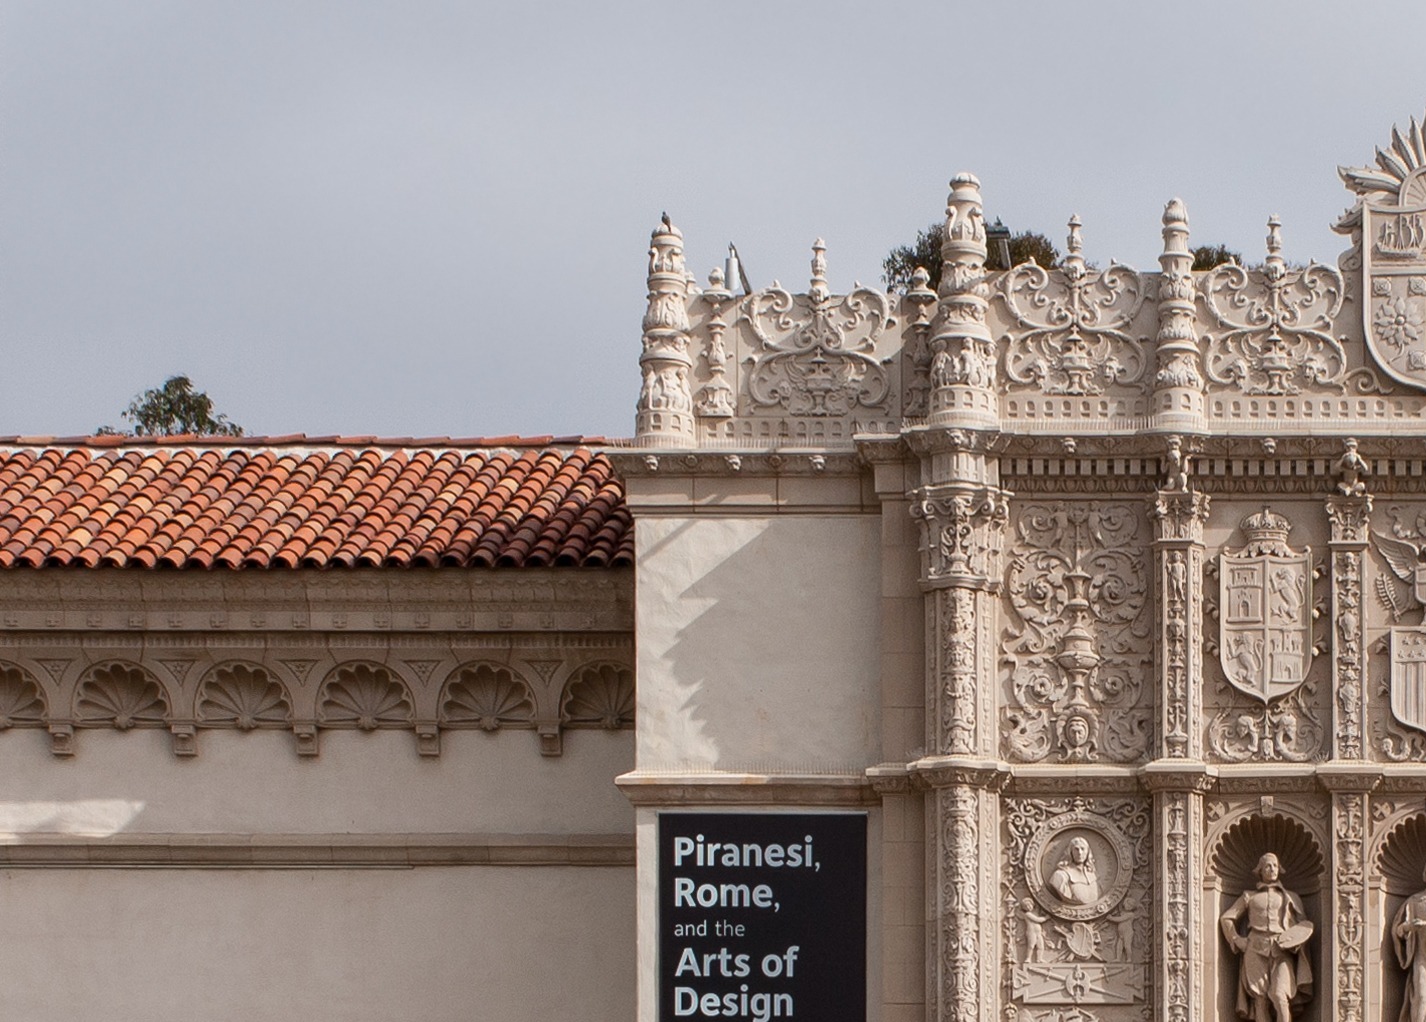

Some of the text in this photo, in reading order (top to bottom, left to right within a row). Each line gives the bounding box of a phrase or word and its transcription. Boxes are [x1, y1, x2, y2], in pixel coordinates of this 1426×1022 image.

[674, 833, 821, 872] Piranesi,
[674, 877, 781, 912] Rome,
[674, 919, 746, 937] and the
[674, 945, 800, 978] Arts of
